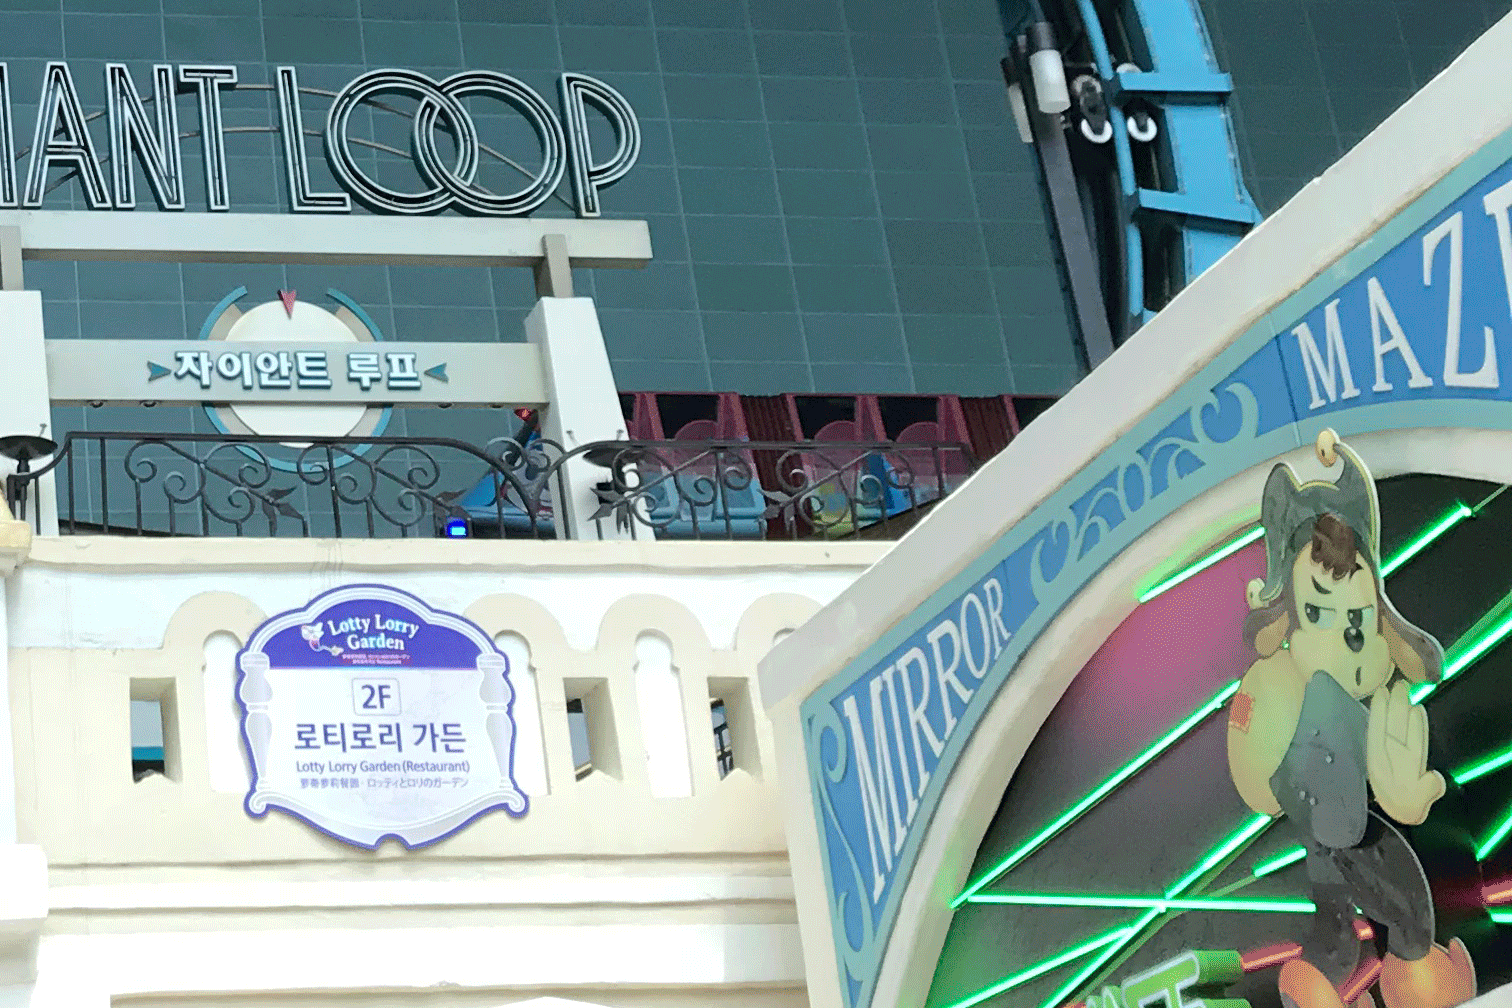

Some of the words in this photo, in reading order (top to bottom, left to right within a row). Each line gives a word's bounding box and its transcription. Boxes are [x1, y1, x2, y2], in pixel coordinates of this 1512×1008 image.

[278, 66, 641, 218] LOOP
[174, 351, 332, 390] 자이안트
[347, 352, 421, 391] 루프
[327, 617, 370, 636] Lotty
[374, 614, 419, 639] Lorry
[347, 632, 404, 650] Garden
[361, 684, 391, 709] 2F
[294, 722, 402, 753] 로티로리
[412, 722, 466, 753] 가든
[843, 578, 1011, 904] MIRROR
[296, 761, 325, 774] Lotty
[328, 761, 357, 774] Lorry
[359, 760, 401, 773] Garden
